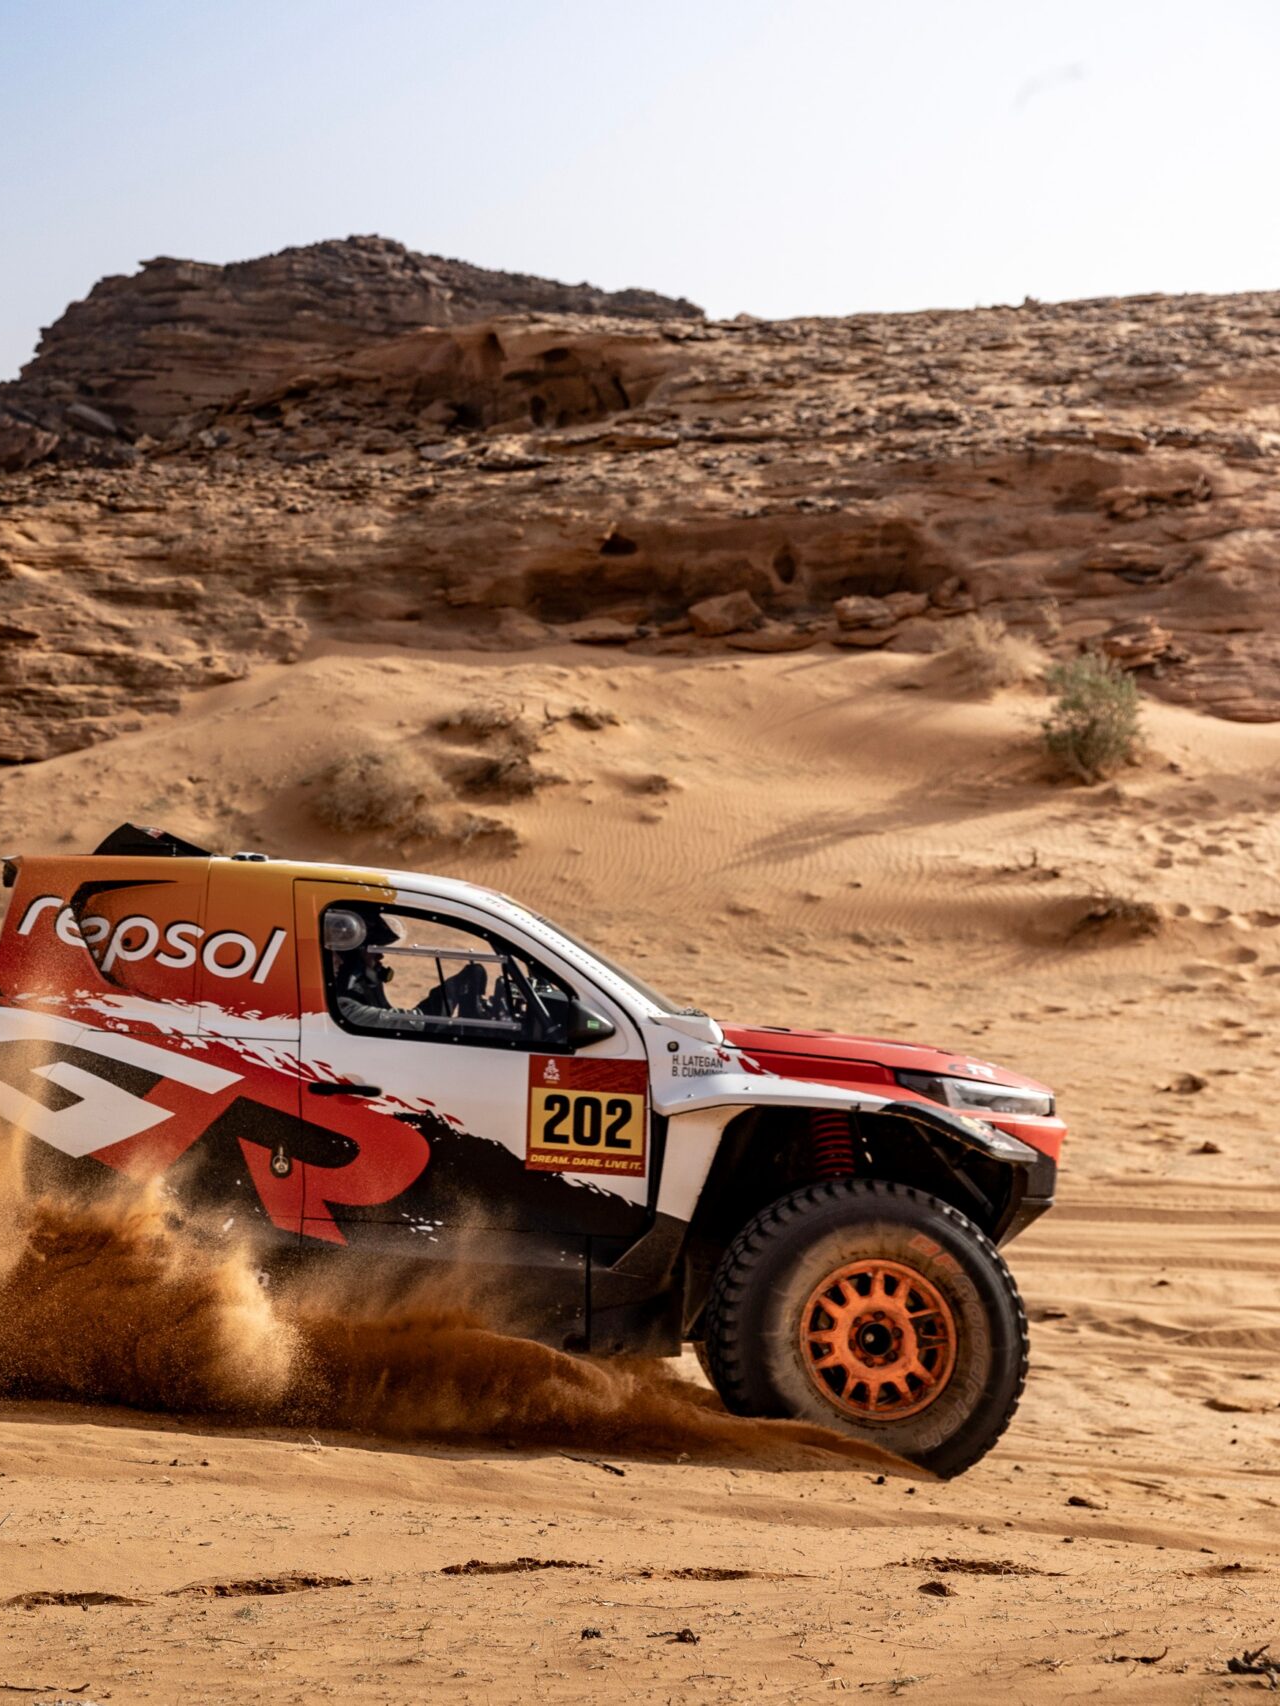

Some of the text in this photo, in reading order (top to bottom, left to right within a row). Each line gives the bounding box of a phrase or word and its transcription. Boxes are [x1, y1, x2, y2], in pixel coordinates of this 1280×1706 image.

[17, 897, 287, 984] repsol
[671, 1055, 723, 1069] H. LATEGAN
[671, 1066, 681, 1077] B.
[543, 1094, 632, 1149] 202
[530, 1154, 643, 1170] DREAM. DARE. LIVE IT.
